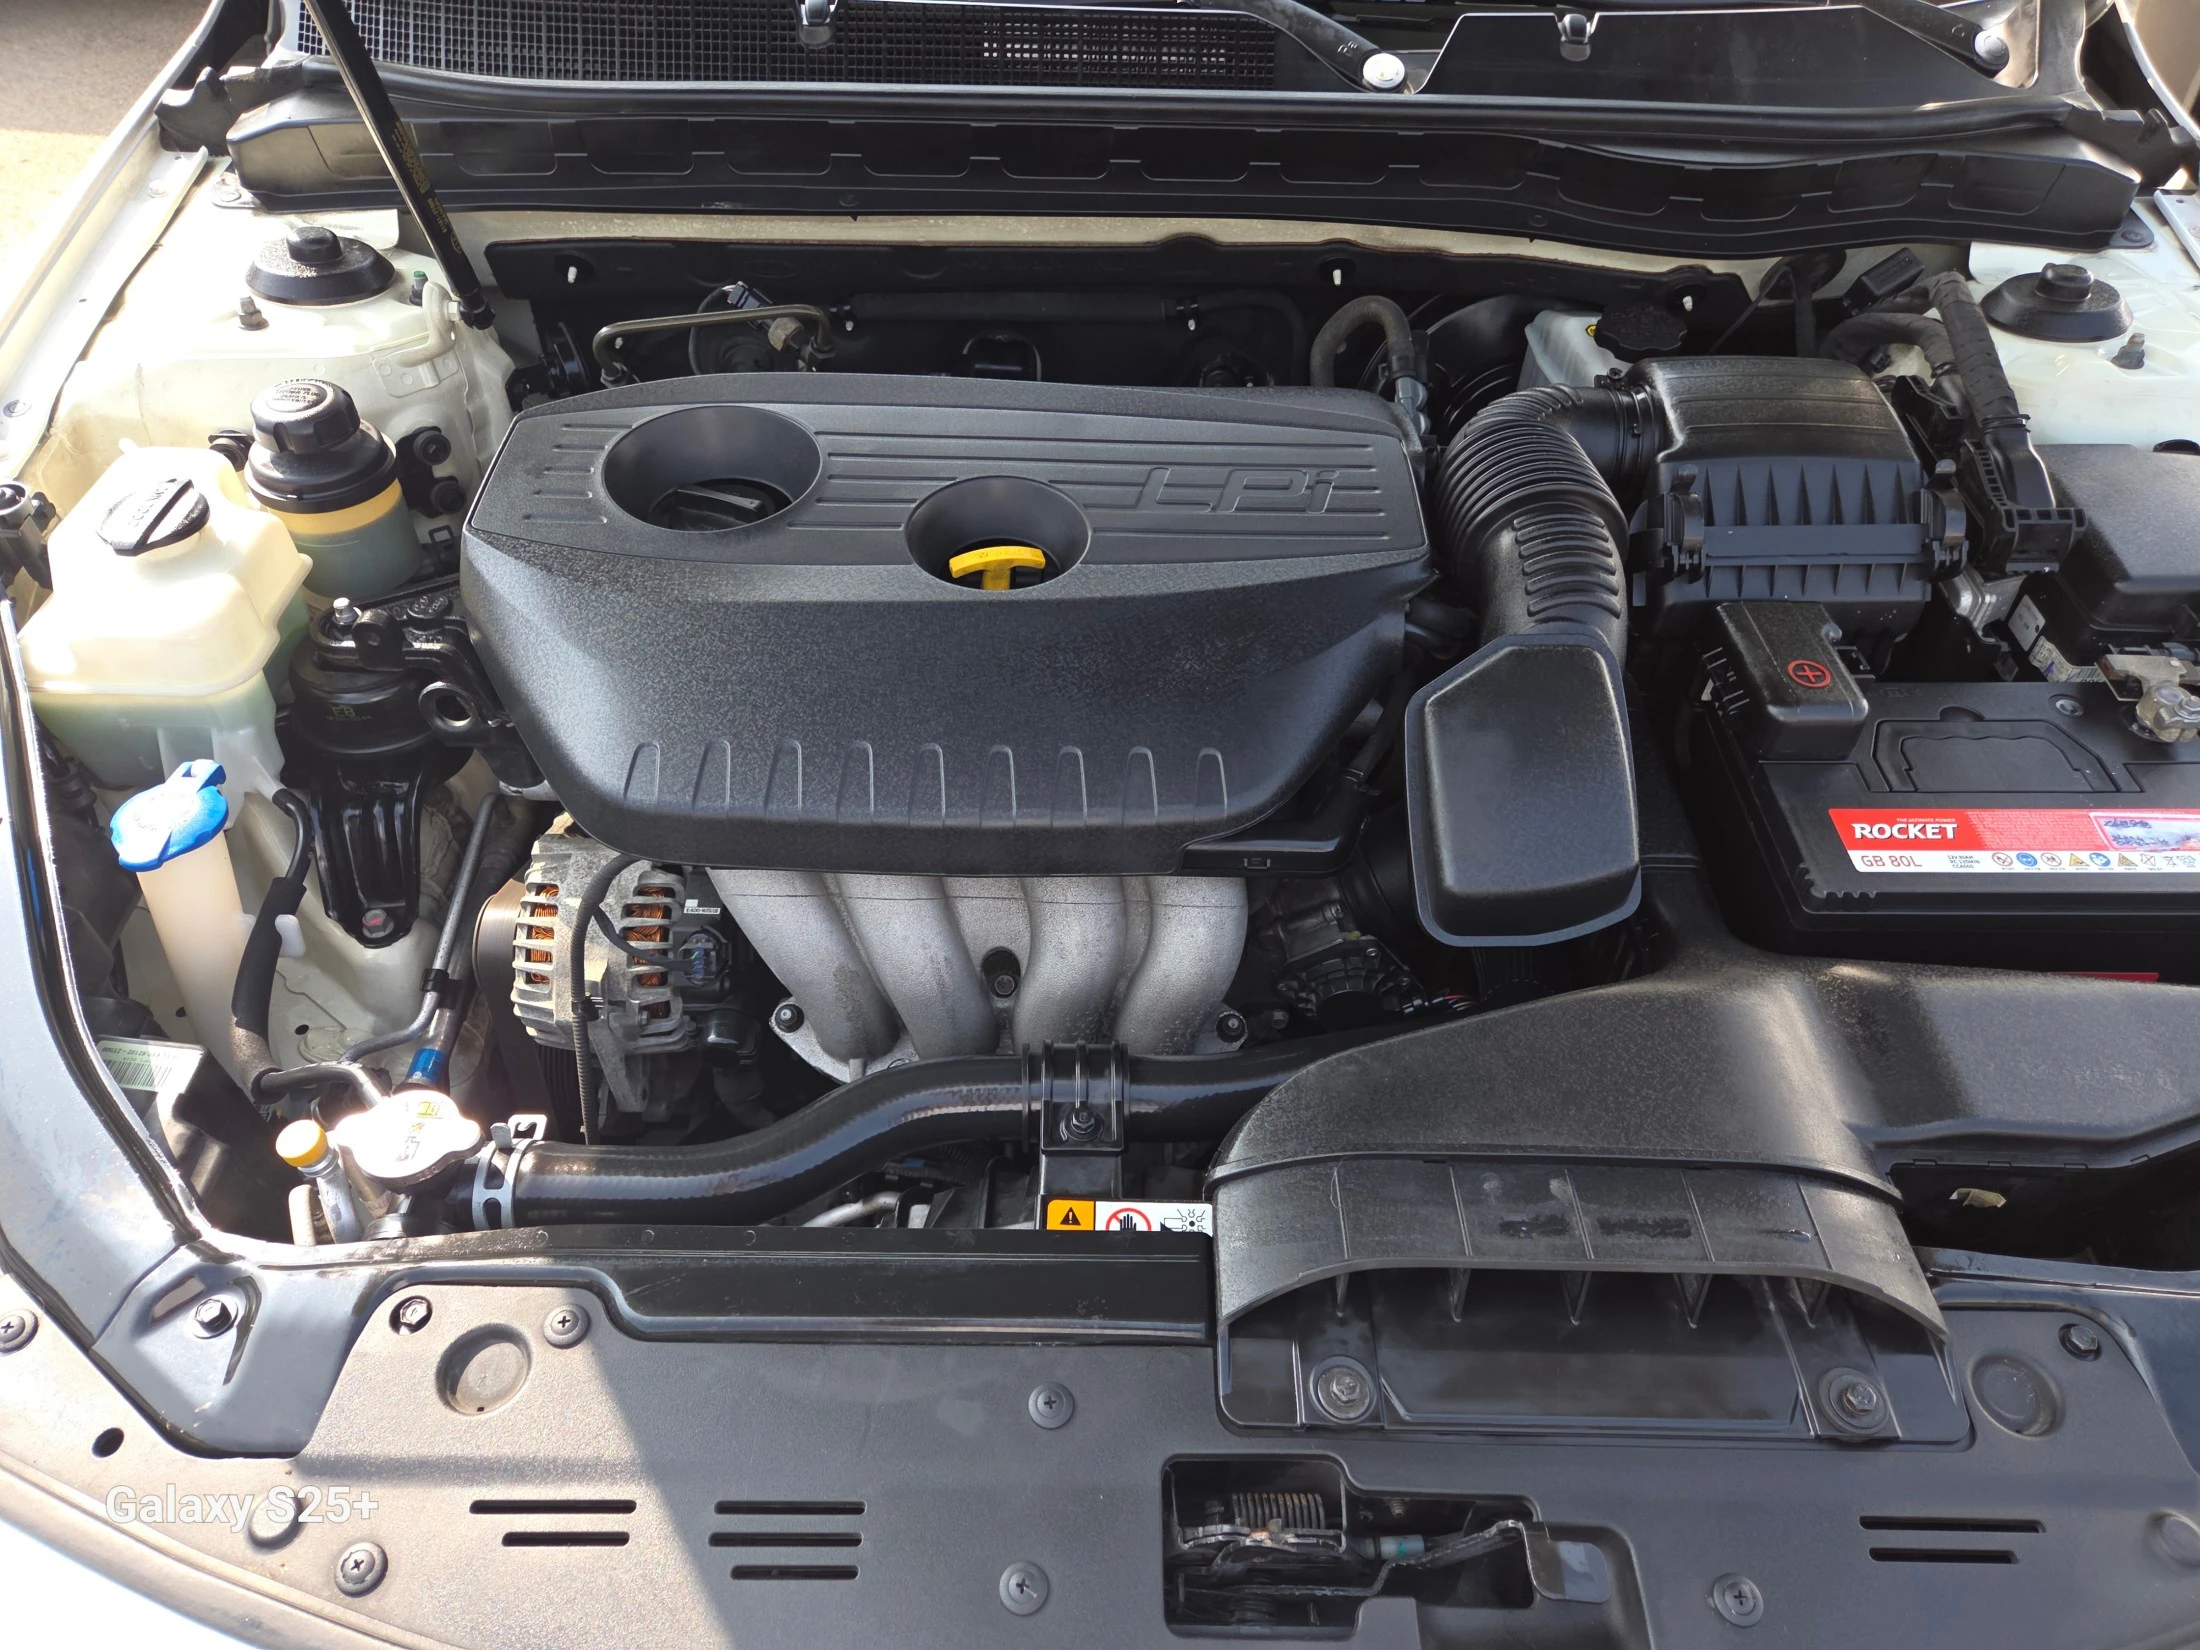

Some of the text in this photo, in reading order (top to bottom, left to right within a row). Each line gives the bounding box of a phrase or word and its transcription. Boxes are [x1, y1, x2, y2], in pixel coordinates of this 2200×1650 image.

[1136, 466, 1339, 514] LPi
[1850, 823, 1958, 840] ROCKET
[1861, 855, 1923, 867] GB 80L
